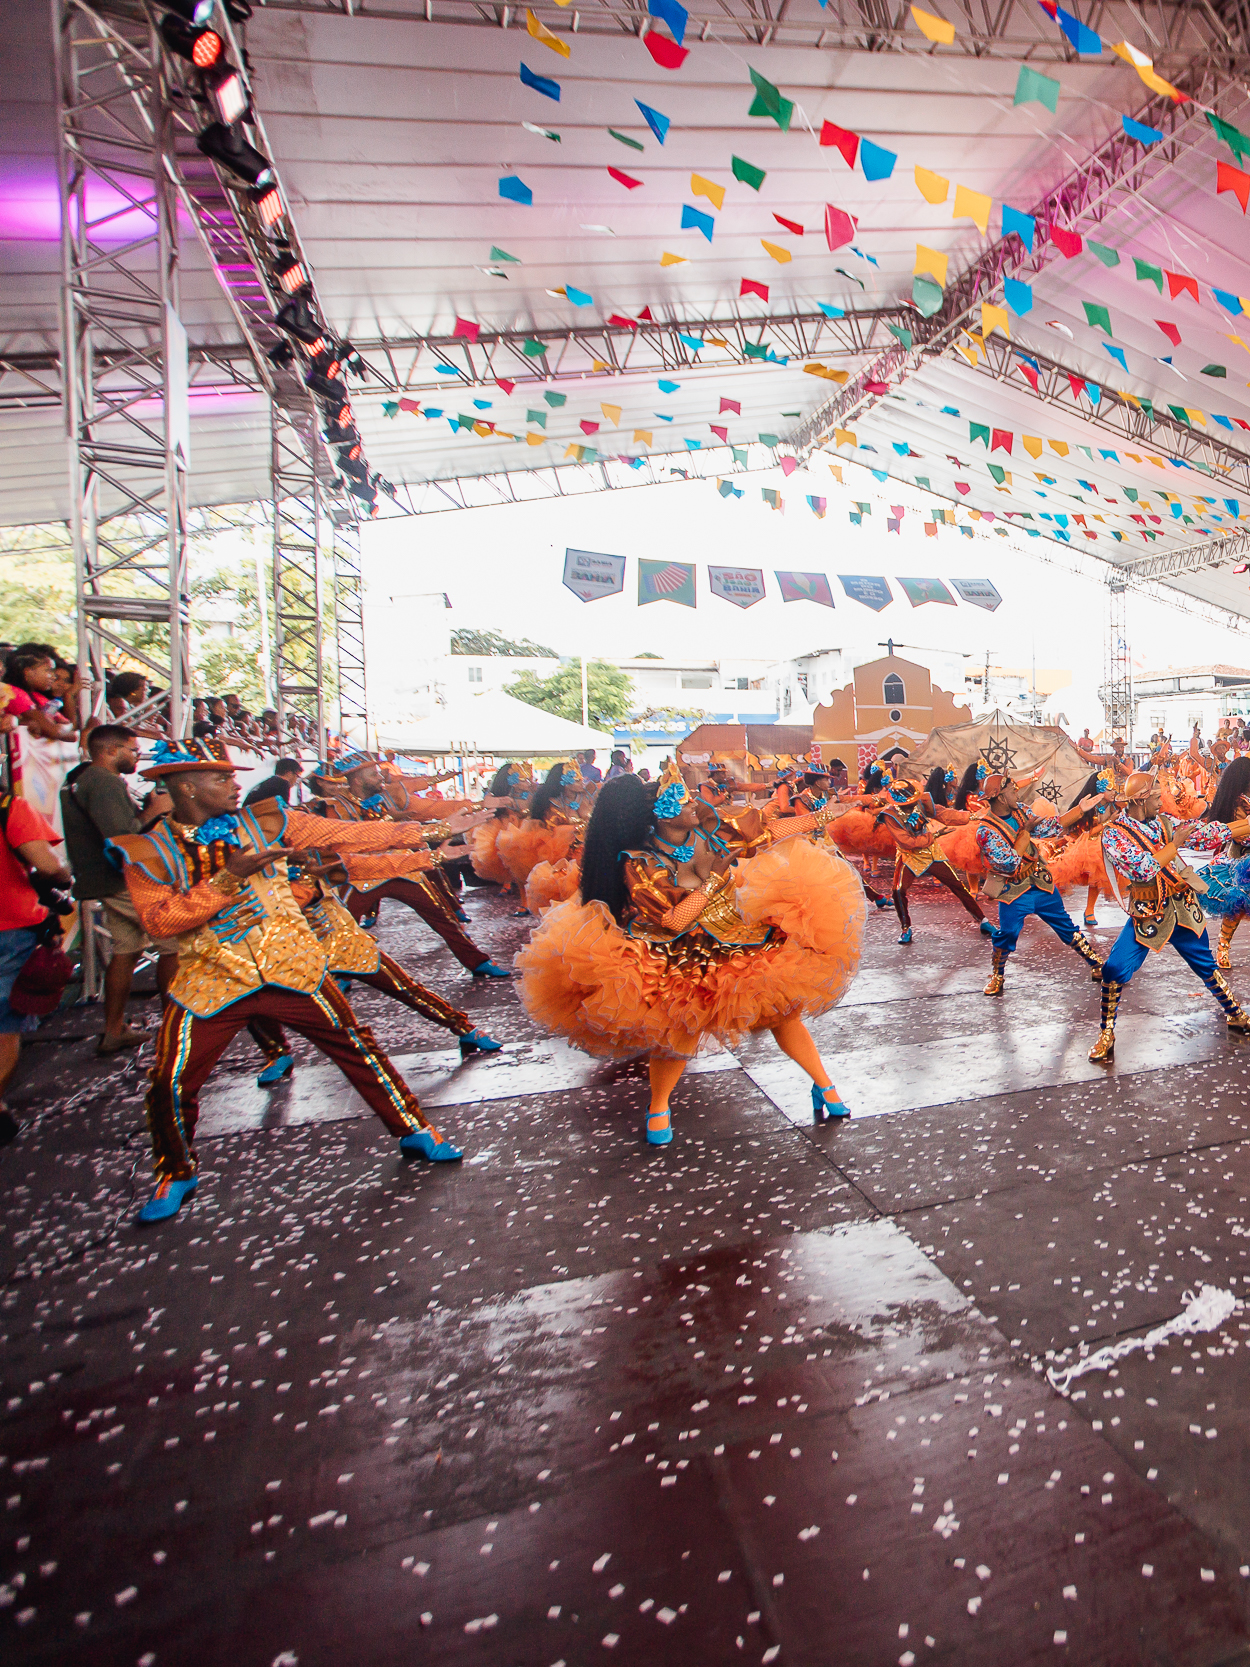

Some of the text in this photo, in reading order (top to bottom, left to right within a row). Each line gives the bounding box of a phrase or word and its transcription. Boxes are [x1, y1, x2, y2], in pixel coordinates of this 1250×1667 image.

[571, 571, 615, 584] BAHIA
[722, 571, 758, 582] SÃO
[722, 584, 760, 594] BAHIA
